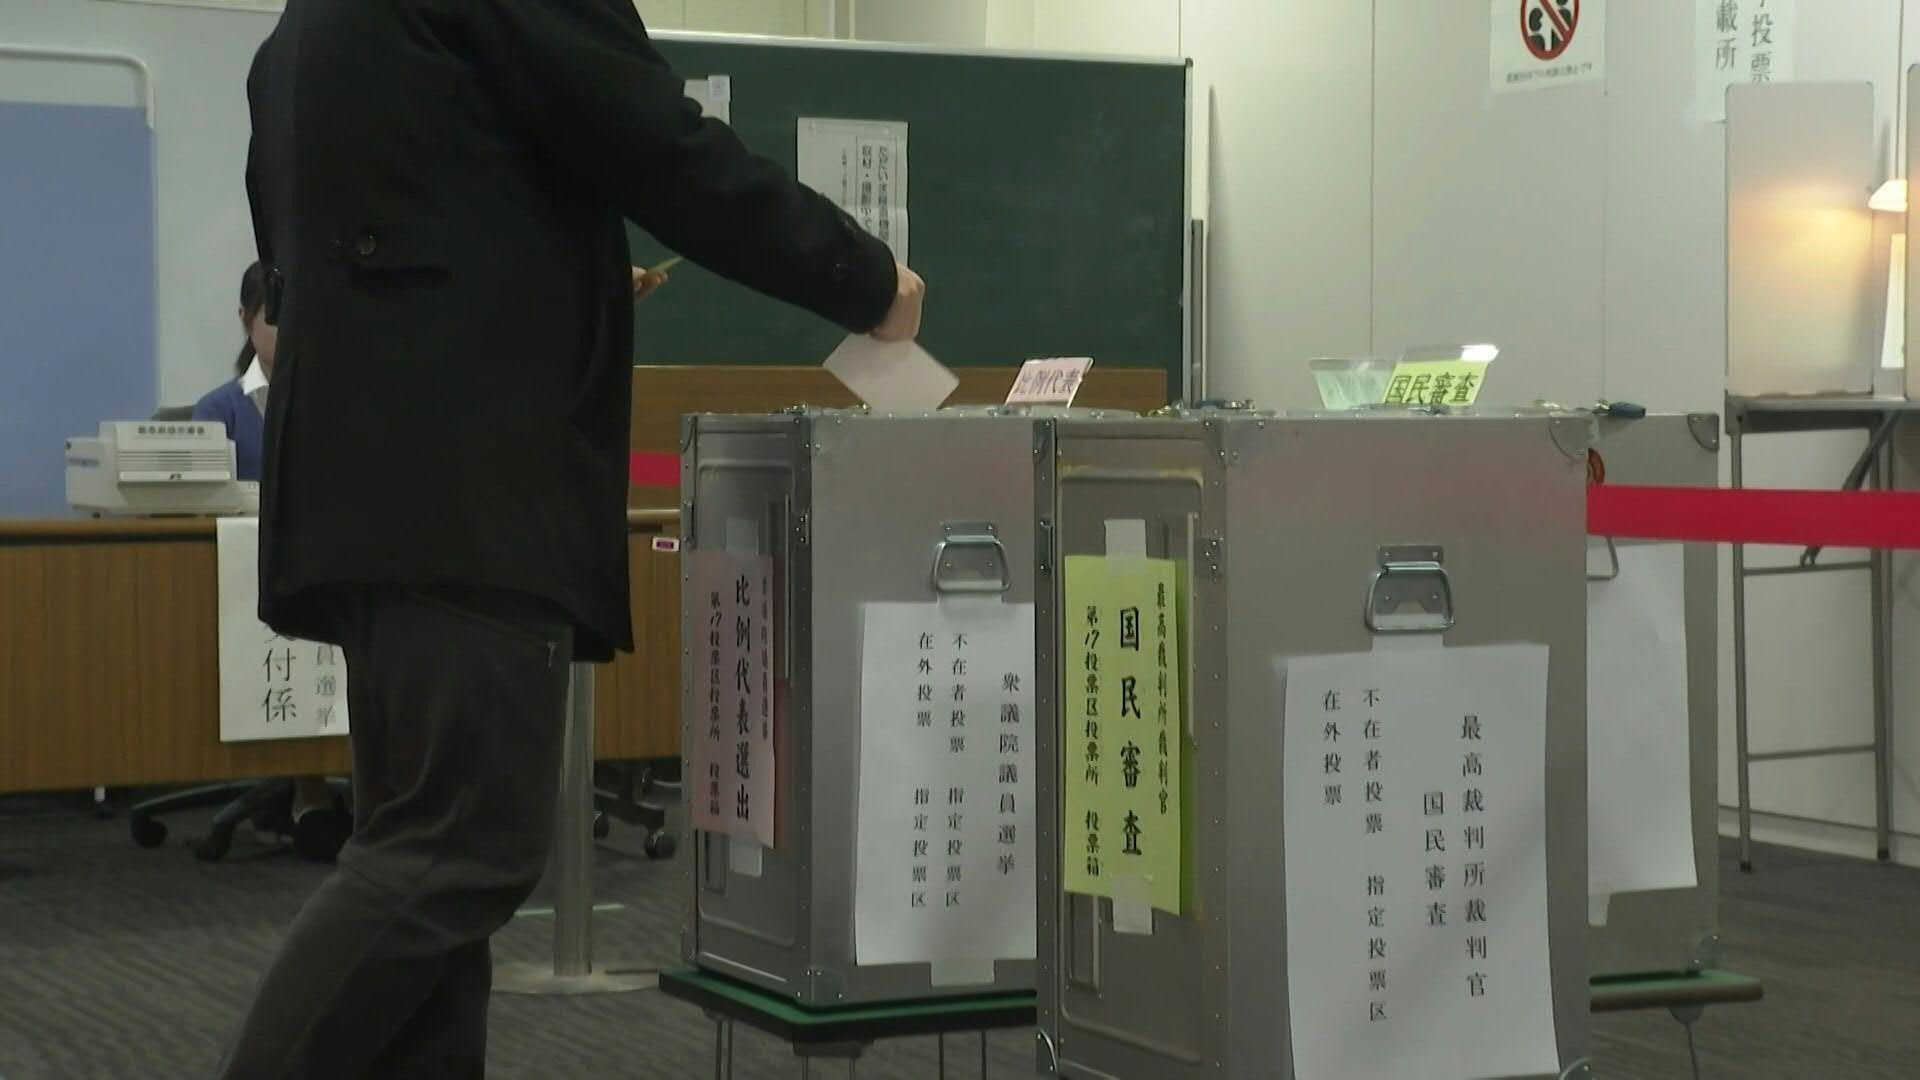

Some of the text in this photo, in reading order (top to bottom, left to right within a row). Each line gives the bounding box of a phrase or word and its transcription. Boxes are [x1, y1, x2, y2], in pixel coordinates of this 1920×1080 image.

[1751, 0, 1774, 84] 投票
[1383, 371, 1479, 405] 国民審査
[262, 622, 297, 723] 付係
[736, 573, 751, 821] 比例代表選出
[911, 632, 934, 907] 在外投票 指定投票区
[946, 633, 967, 907] 不在者投票 指定投票区
[997, 671, 1020, 875] 衆議院議員選挙
[1119, 605, 1143, 856] 国民審査
[1323, 689, 1343, 805] 在外投票
[1363, 689, 1388, 1022] 不在者投票 指定投票区
[1424, 790, 1447, 927] 国民審査
[1461, 714, 1488, 998] 最高裁判所裁判官
